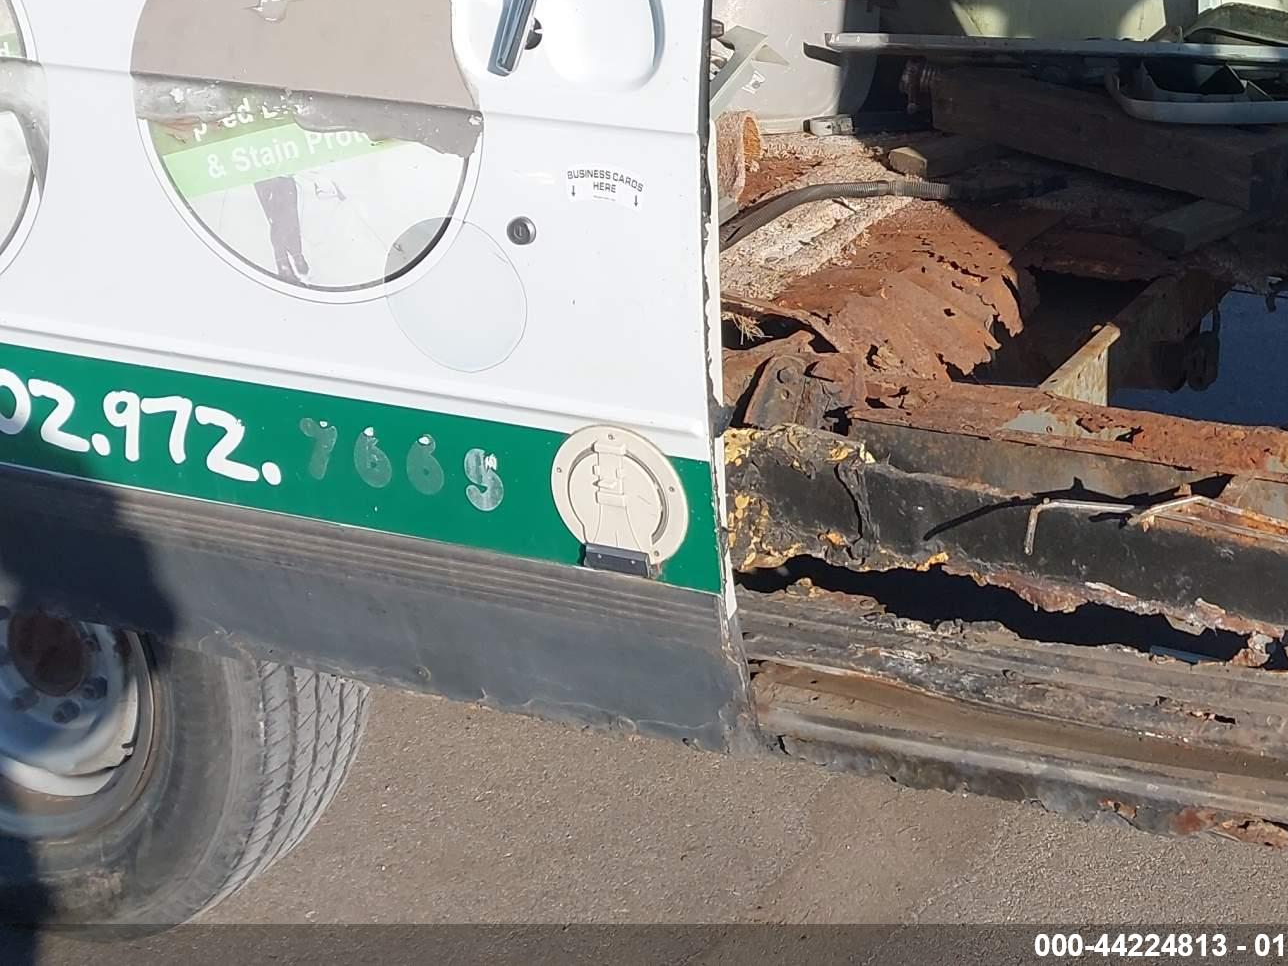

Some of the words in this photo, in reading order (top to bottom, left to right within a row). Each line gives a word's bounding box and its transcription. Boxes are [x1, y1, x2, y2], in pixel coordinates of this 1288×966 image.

[207, 153, 227, 179] &
[231, 138, 299, 173] Stain
[567, 169, 611, 180] BUSINESS
[612, 172, 644, 193] CARDS
[593, 181, 617, 193] HERE
